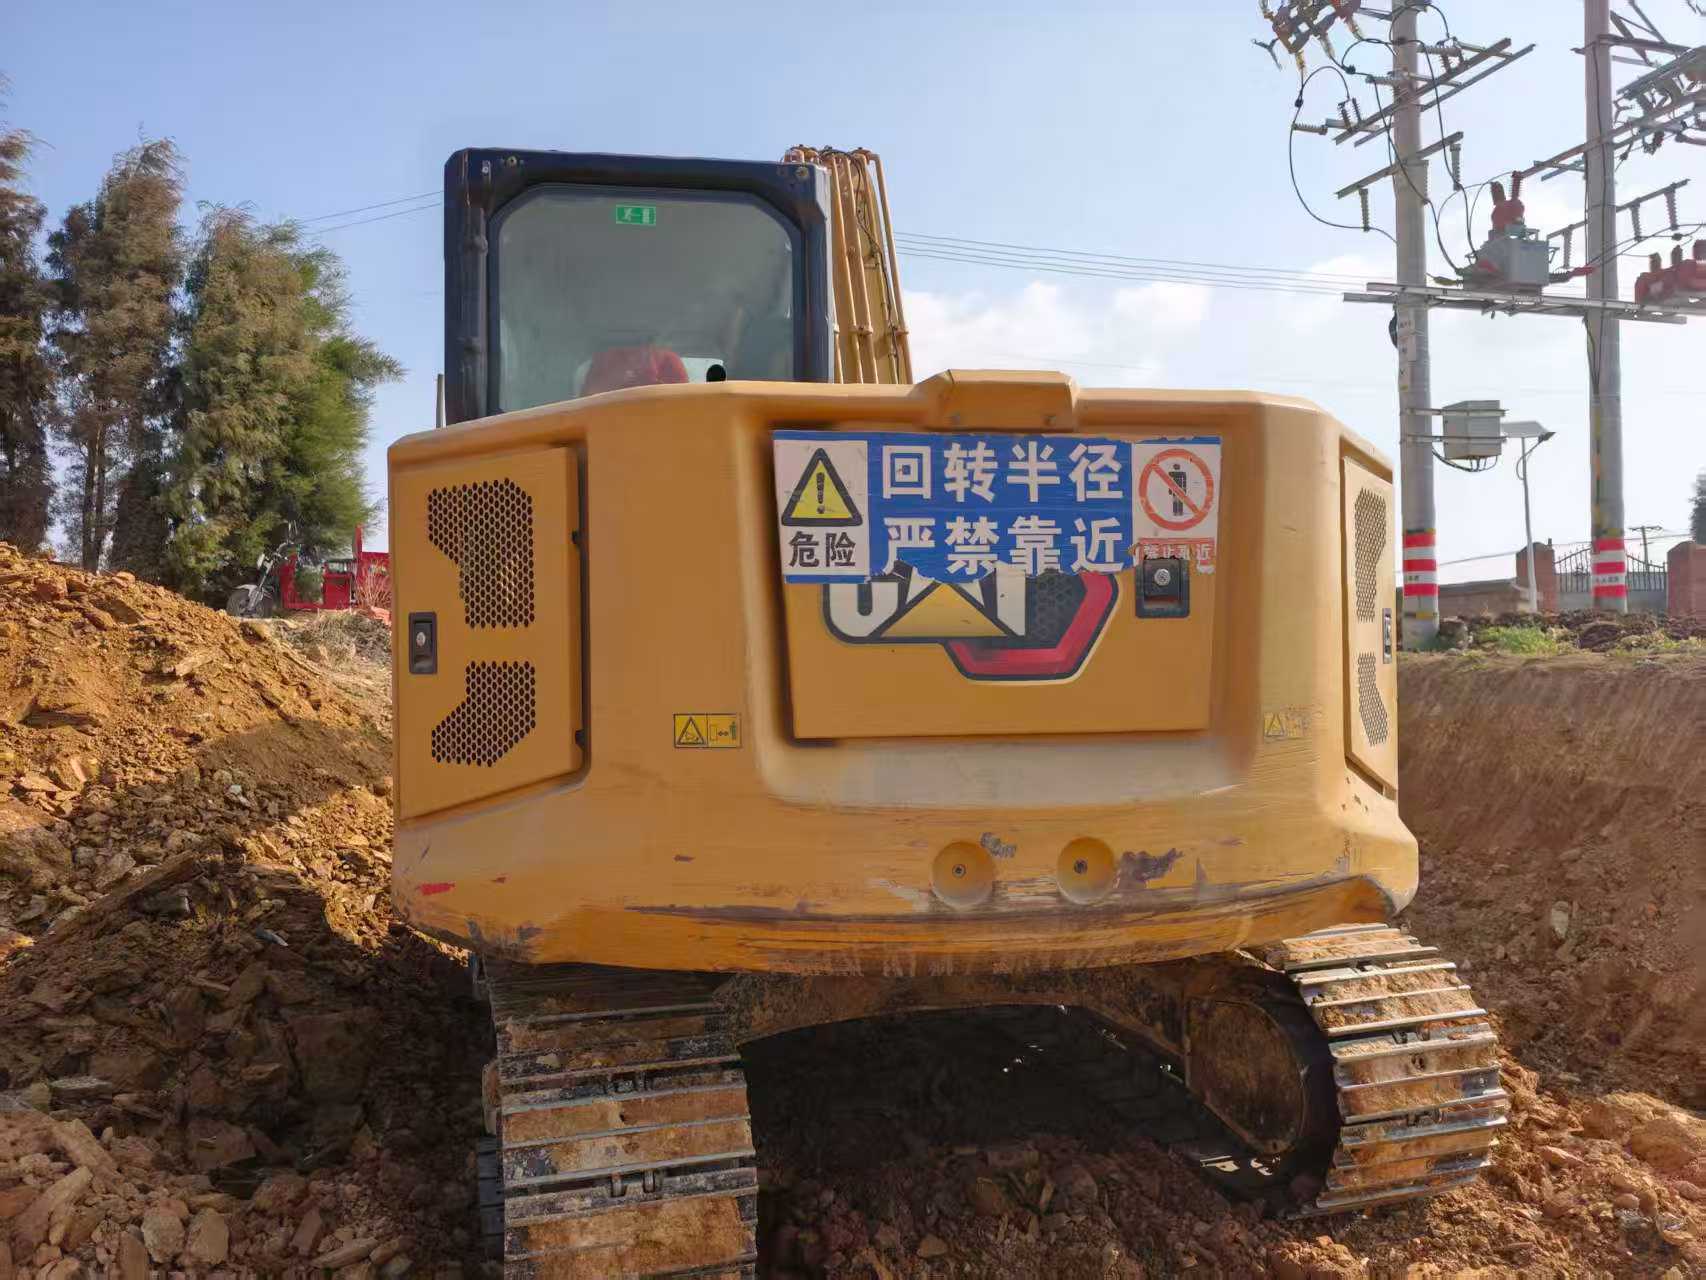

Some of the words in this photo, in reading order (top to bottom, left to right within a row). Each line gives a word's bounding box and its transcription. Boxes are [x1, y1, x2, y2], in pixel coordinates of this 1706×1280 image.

[882, 441, 1123, 502] 回转半径
[788, 531, 856, 567] 危险
[882, 515, 1123, 576] 严禁靠近
